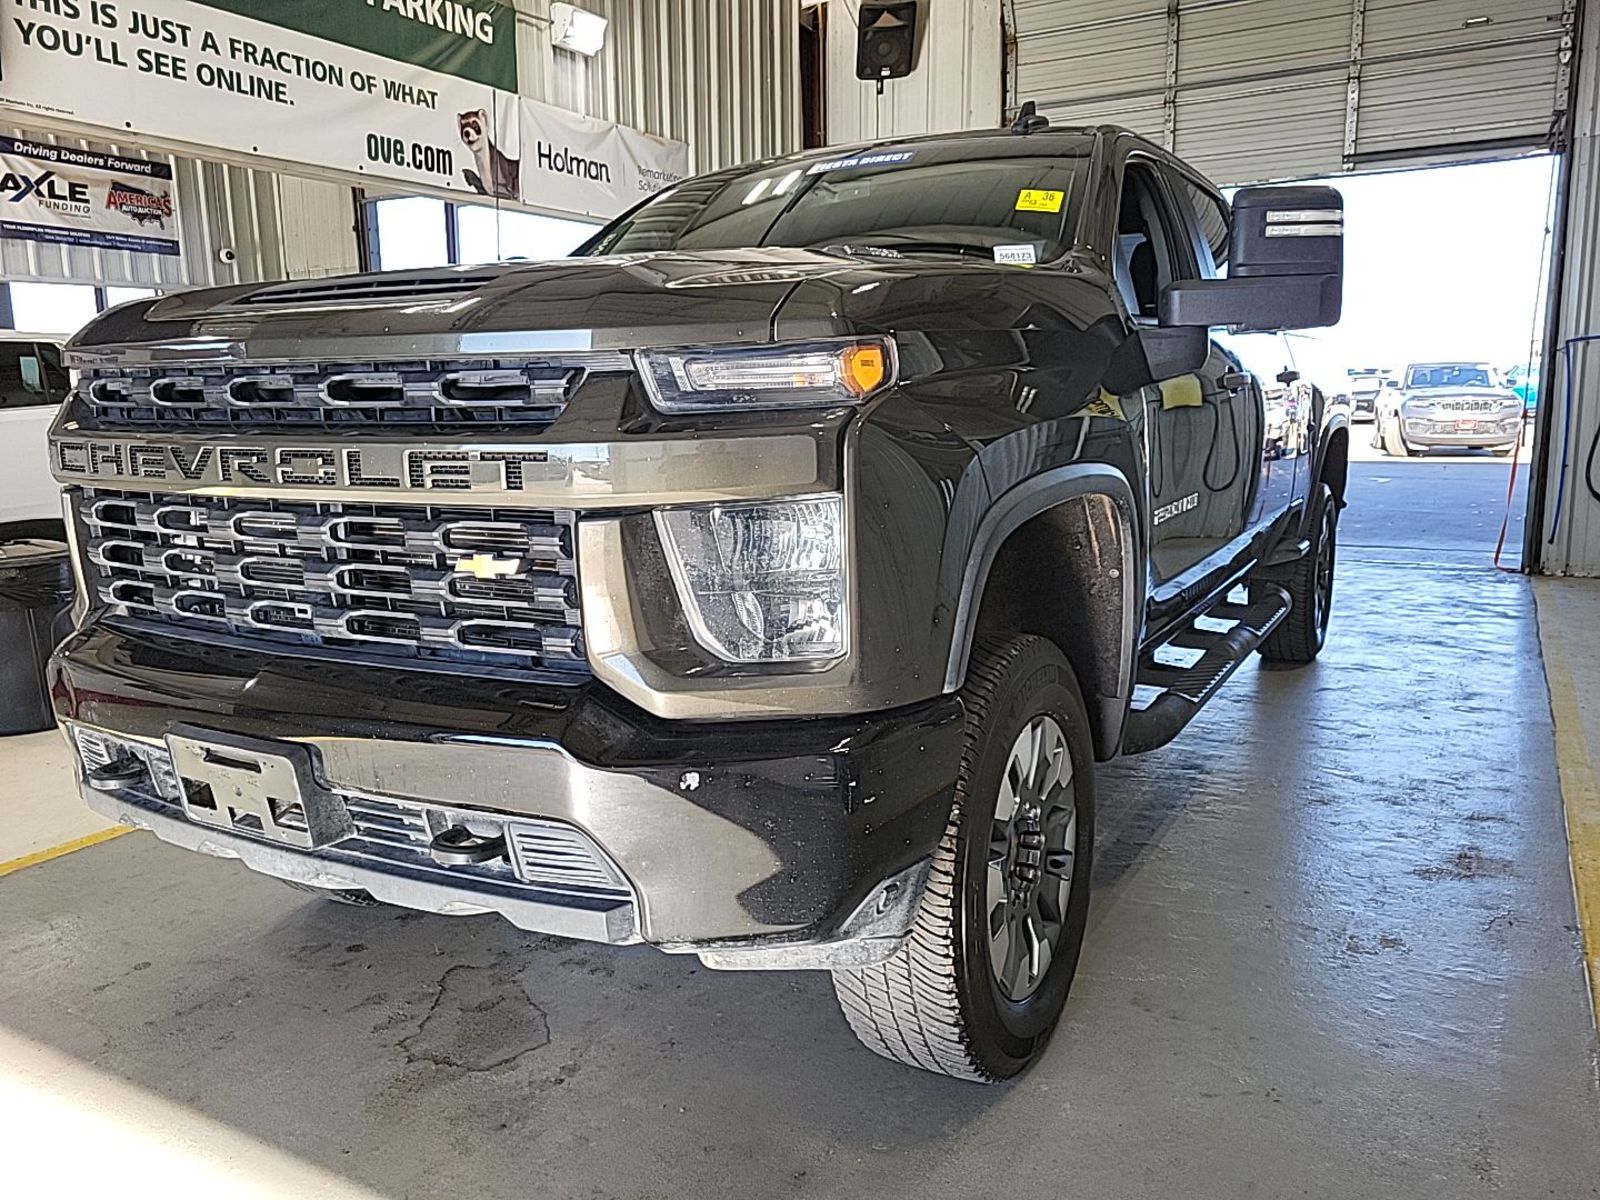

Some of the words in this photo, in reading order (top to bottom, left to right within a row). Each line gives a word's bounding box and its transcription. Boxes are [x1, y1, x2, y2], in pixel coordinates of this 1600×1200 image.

[366, 0, 493, 44] ARKING
[13, 18, 128, 67] YOU'LL
[137, 48, 187, 80] SEE
[196, 62, 295, 106] ONLINE.
[15, 0, 80, 19] HIS
[91, 0, 117, 28] IS
[128, 11, 191, 47] JUST
[201, 31, 220, 55] A
[229, 38, 344, 87] FRACTION
[350, 70, 377, 93] OF
[382, 79, 438, 110] WHAT
[14, 142, 57, 160] Driving
[107, 158, 151, 173] Forward
[366, 133, 453, 176] ove.com
[537, 141, 611, 184] Holman
[0, 170, 90, 204] AXLE
[38, 199, 91, 214] FUNDING
[121, 204, 138, 212] AUTO
[1023, 192, 1031, 200] A
[1042, 191, 1056, 201] 36
[58, 441, 548, 490] CHEVROLET
